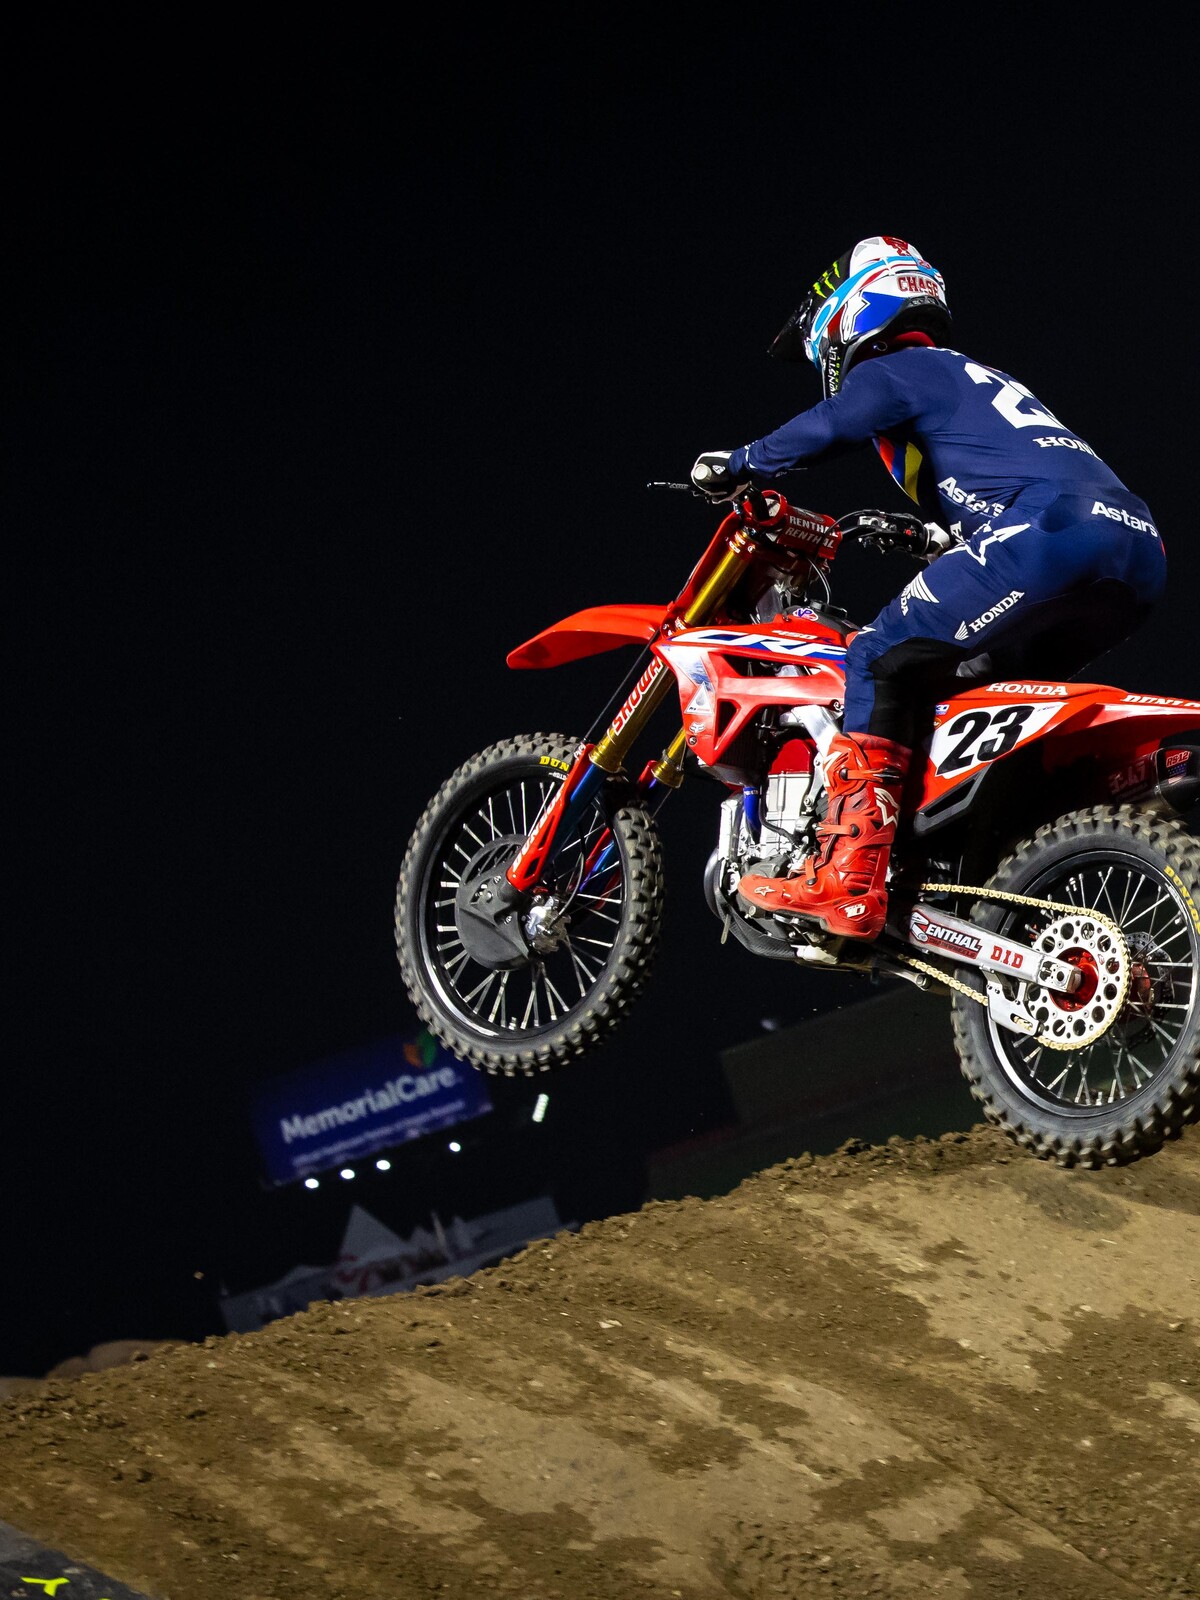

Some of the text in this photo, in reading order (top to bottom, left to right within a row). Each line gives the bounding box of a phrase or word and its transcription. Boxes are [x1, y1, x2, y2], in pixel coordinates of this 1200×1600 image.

[897, 275, 940, 299] CHASE
[1032, 436, 1105, 463] HON
[937, 475, 1006, 518] Astars
[1091, 500, 1159, 538] Astars
[969, 589, 1026, 634] HONDA
[612, 655, 666, 736] SHOWA
[986, 682, 1069, 696] HONDA
[936, 705, 1036, 776] 23
[539, 755, 570, 772] DUN
[990, 944, 1025, 969] D.I.D
[278, 1065, 458, 1144] MemorialCare
